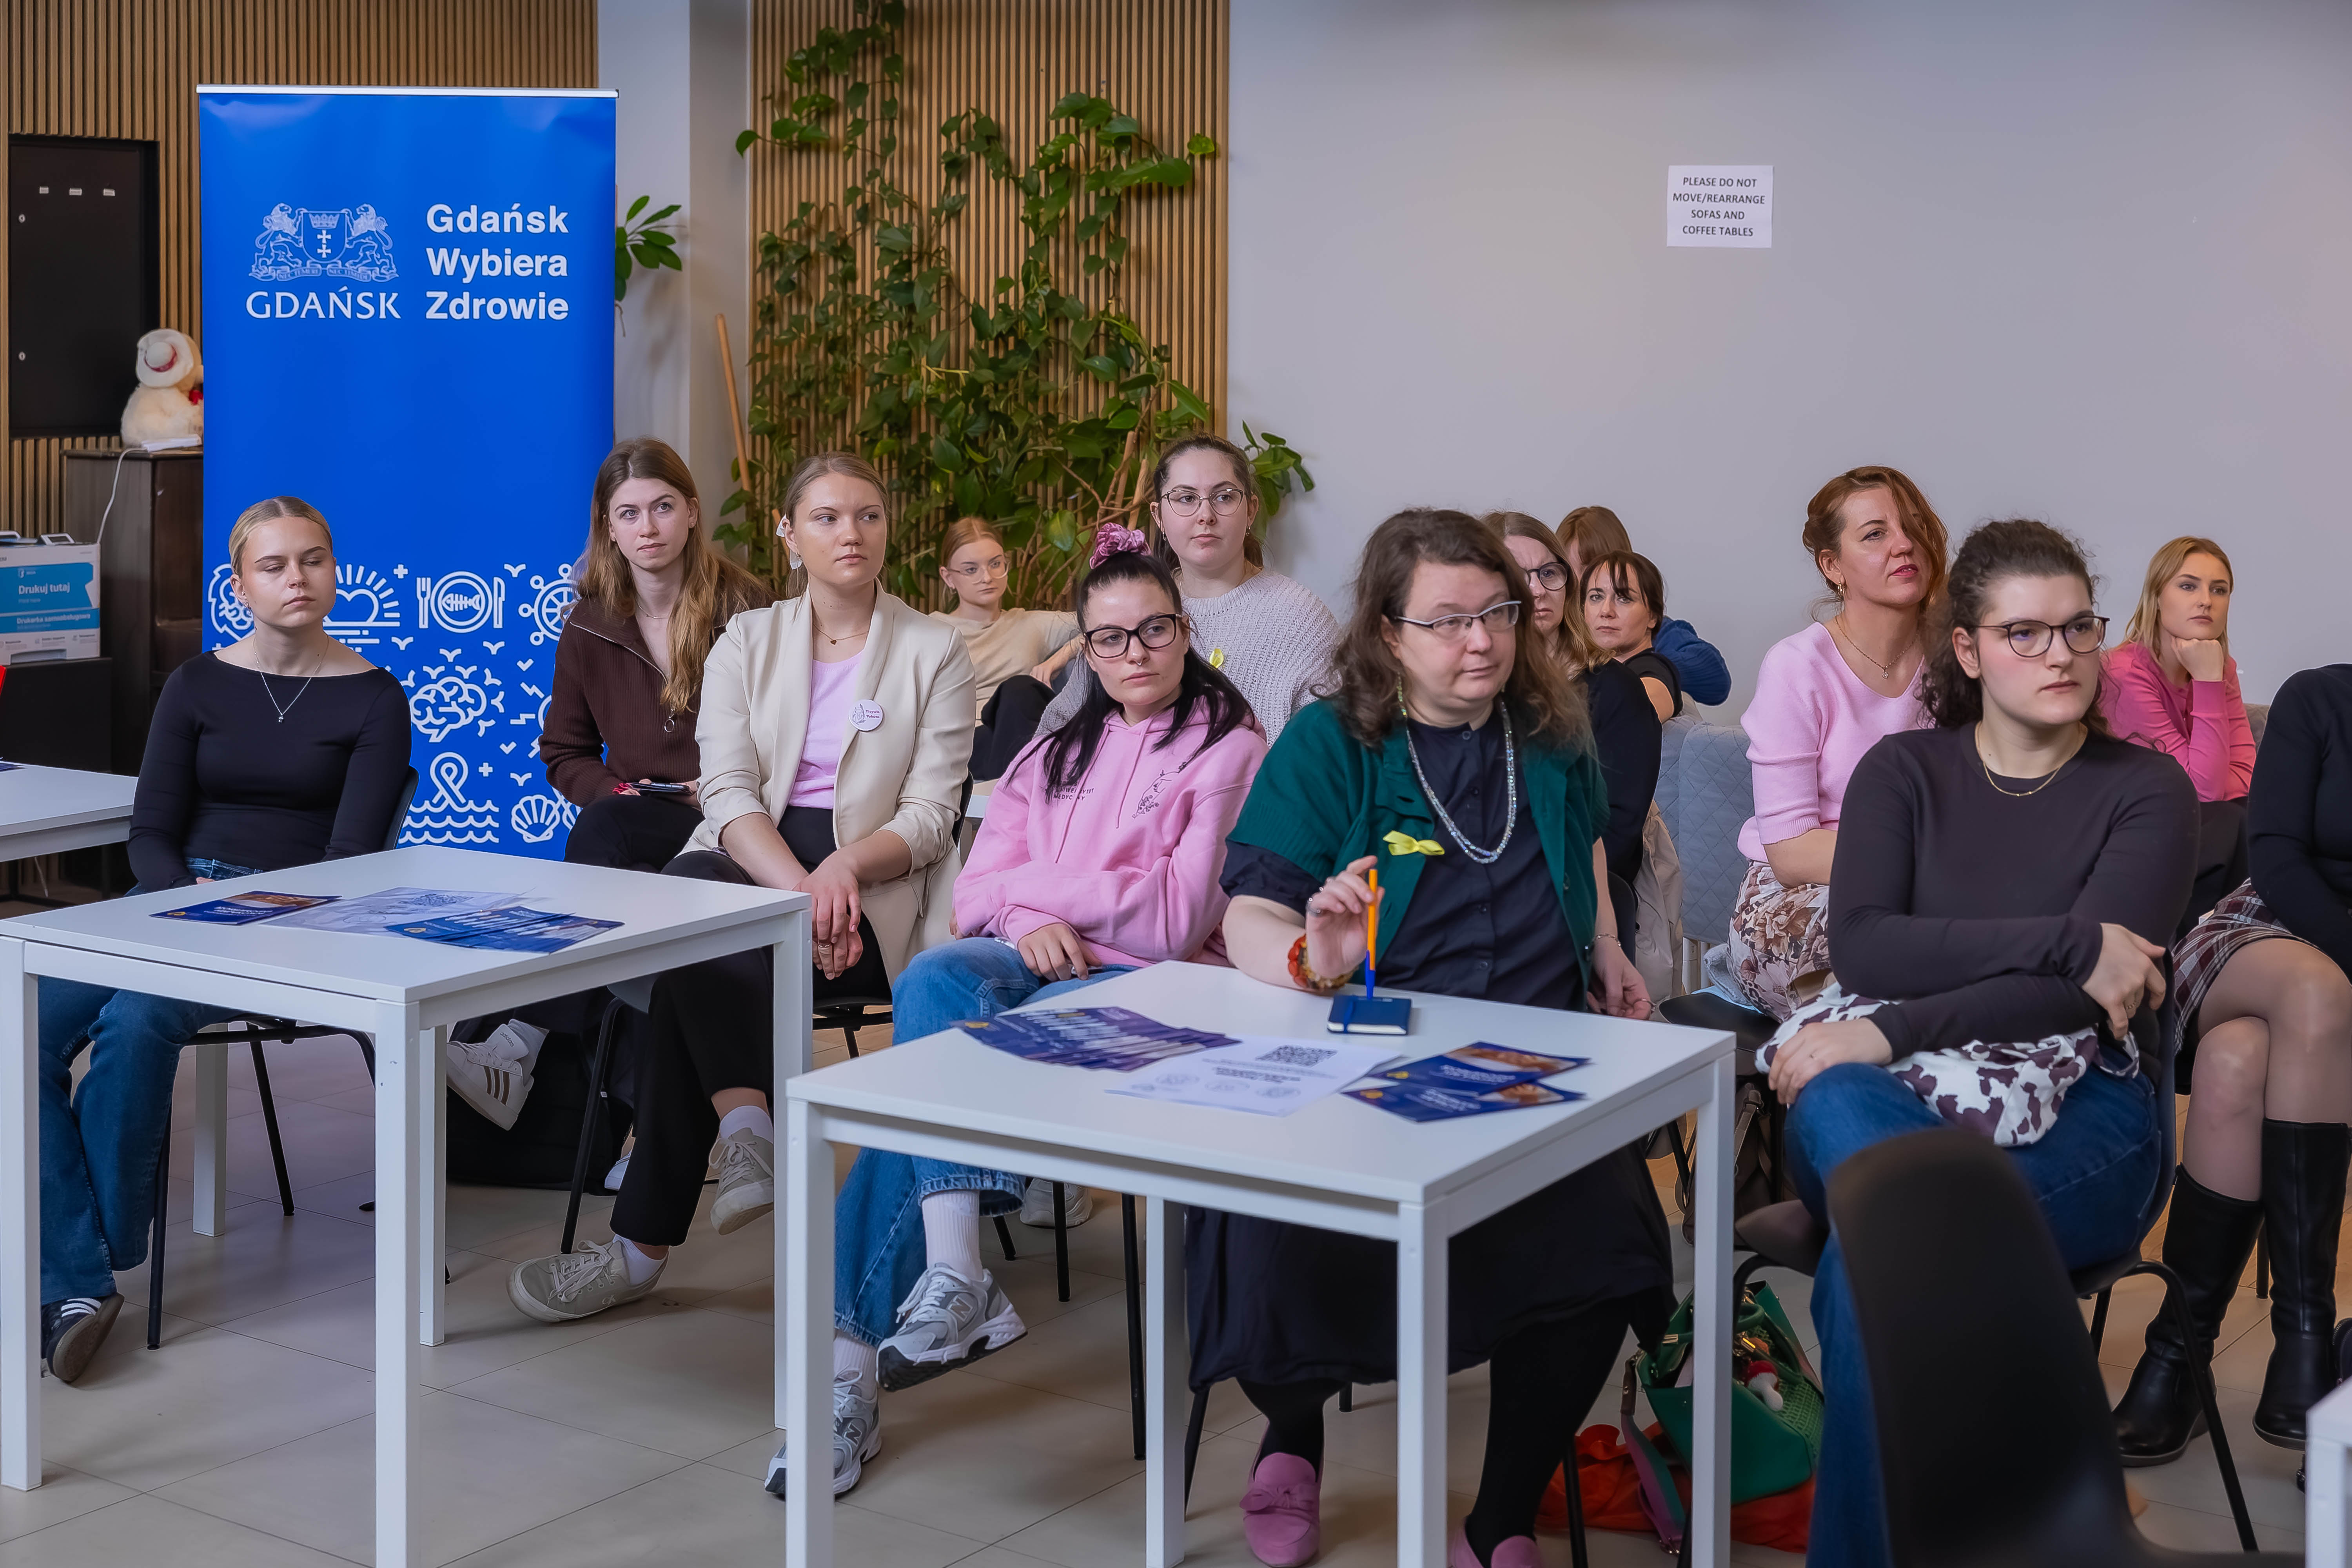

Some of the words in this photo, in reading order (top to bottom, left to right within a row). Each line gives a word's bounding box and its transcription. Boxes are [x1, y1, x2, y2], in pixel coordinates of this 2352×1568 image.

[1683, 177, 1717, 187] PLEASE
[1719, 178, 1734, 187] DO
[1737, 179, 1757, 188] NOT
[1673, 193, 1766, 204] MOVE/REARRANGE
[426, 203, 569, 234] Gdańsk
[1691, 209, 1721, 219] SOFAS
[1723, 211, 1745, 220] AND
[1682, 225, 1717, 235] COFFEE
[1719, 227, 1754, 237] TABLES
[426, 248, 568, 283] Wybiera
[245, 286, 401, 319] GDAŃSK
[425, 291, 569, 321] Zdrowie
[18, 583, 48, 595] Drukuj
[50, 582, 71, 593] tutaj
[500, 1032, 514, 1047] adidas
